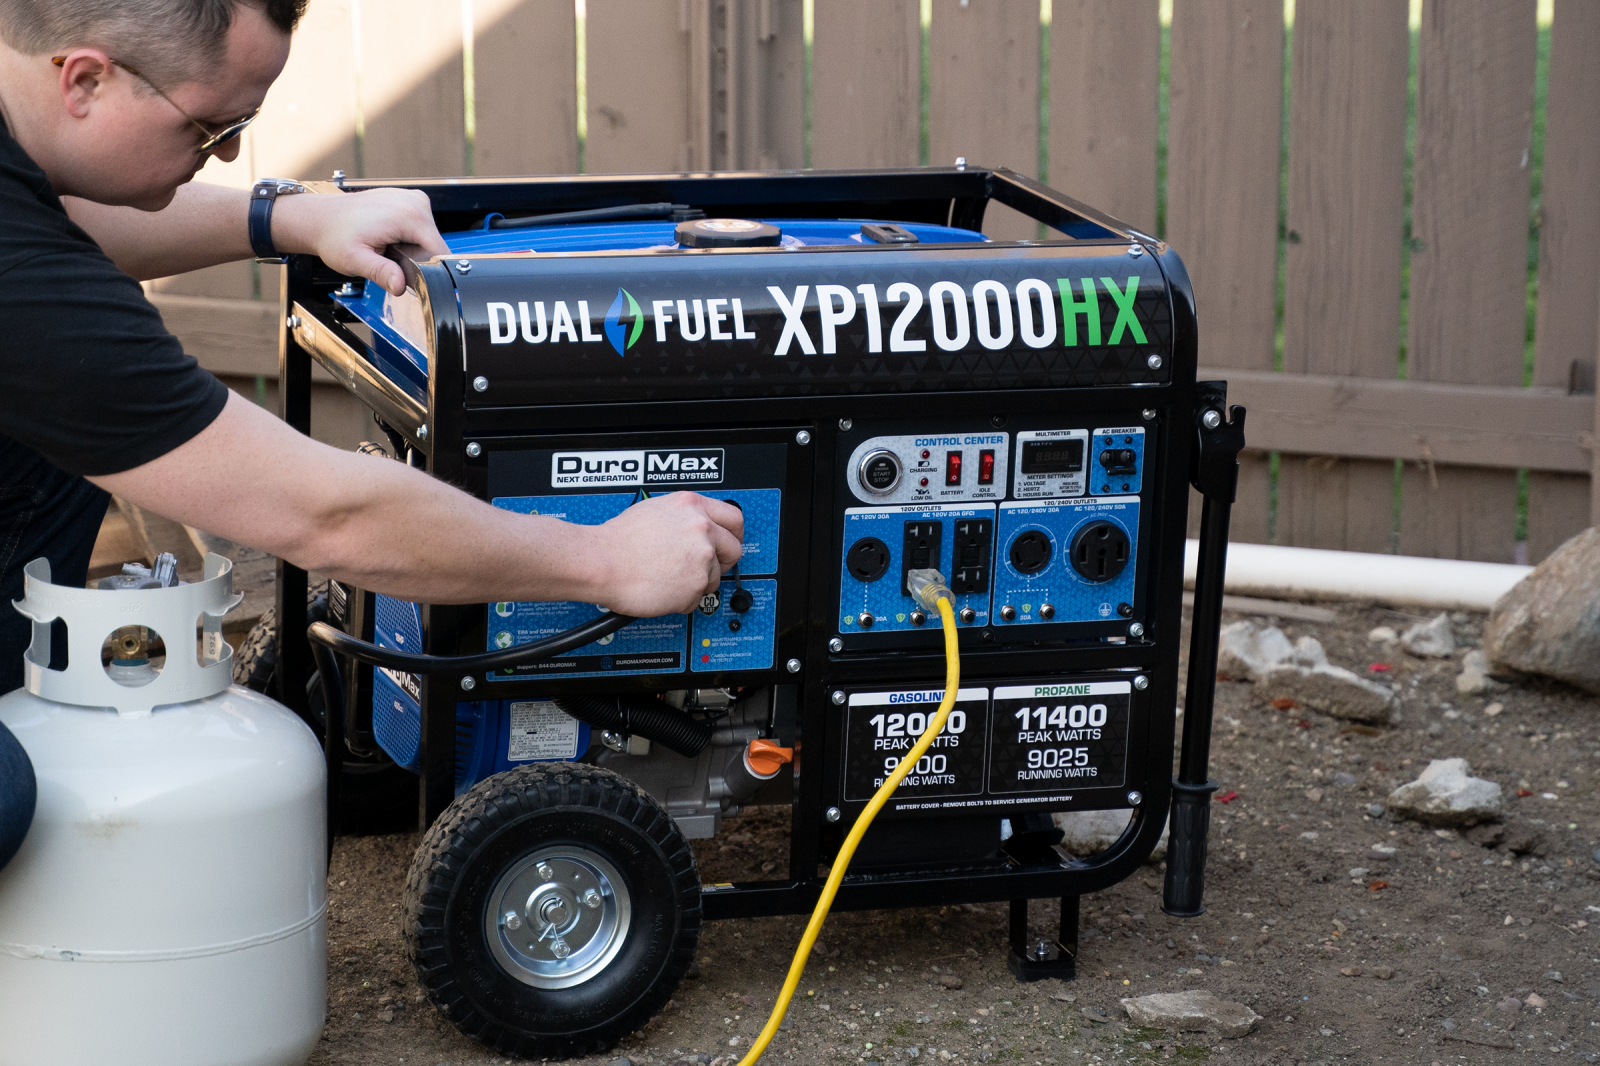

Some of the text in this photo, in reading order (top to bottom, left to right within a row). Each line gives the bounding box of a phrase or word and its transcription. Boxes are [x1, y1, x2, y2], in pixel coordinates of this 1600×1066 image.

[486, 275, 1149, 356] DUAL FUEL XP12000HX
[914, 435, 1003, 447] CONTROL CENTER
[582, 474, 638, 482] GENERATION
[647, 473, 678, 481] POWER
[679, 472, 719, 480] SYSTEMS
[704, 597, 715, 607] CO
[616, 657, 674, 665] DUROMAXPOWER.COM
[889, 692, 946, 703] GASOLIN
[1034, 685, 1091, 697] PROPANE
[1015, 704, 1108, 730] 11400
[1018, 728, 1102, 744] PEAK WATTS
[874, 736, 959, 751] PEAK TTS
[1027, 747, 1089, 769] 9025
[1017, 767, 1098, 780] RUNNING WATTS
[874, 775, 955, 788] RING WATTS
